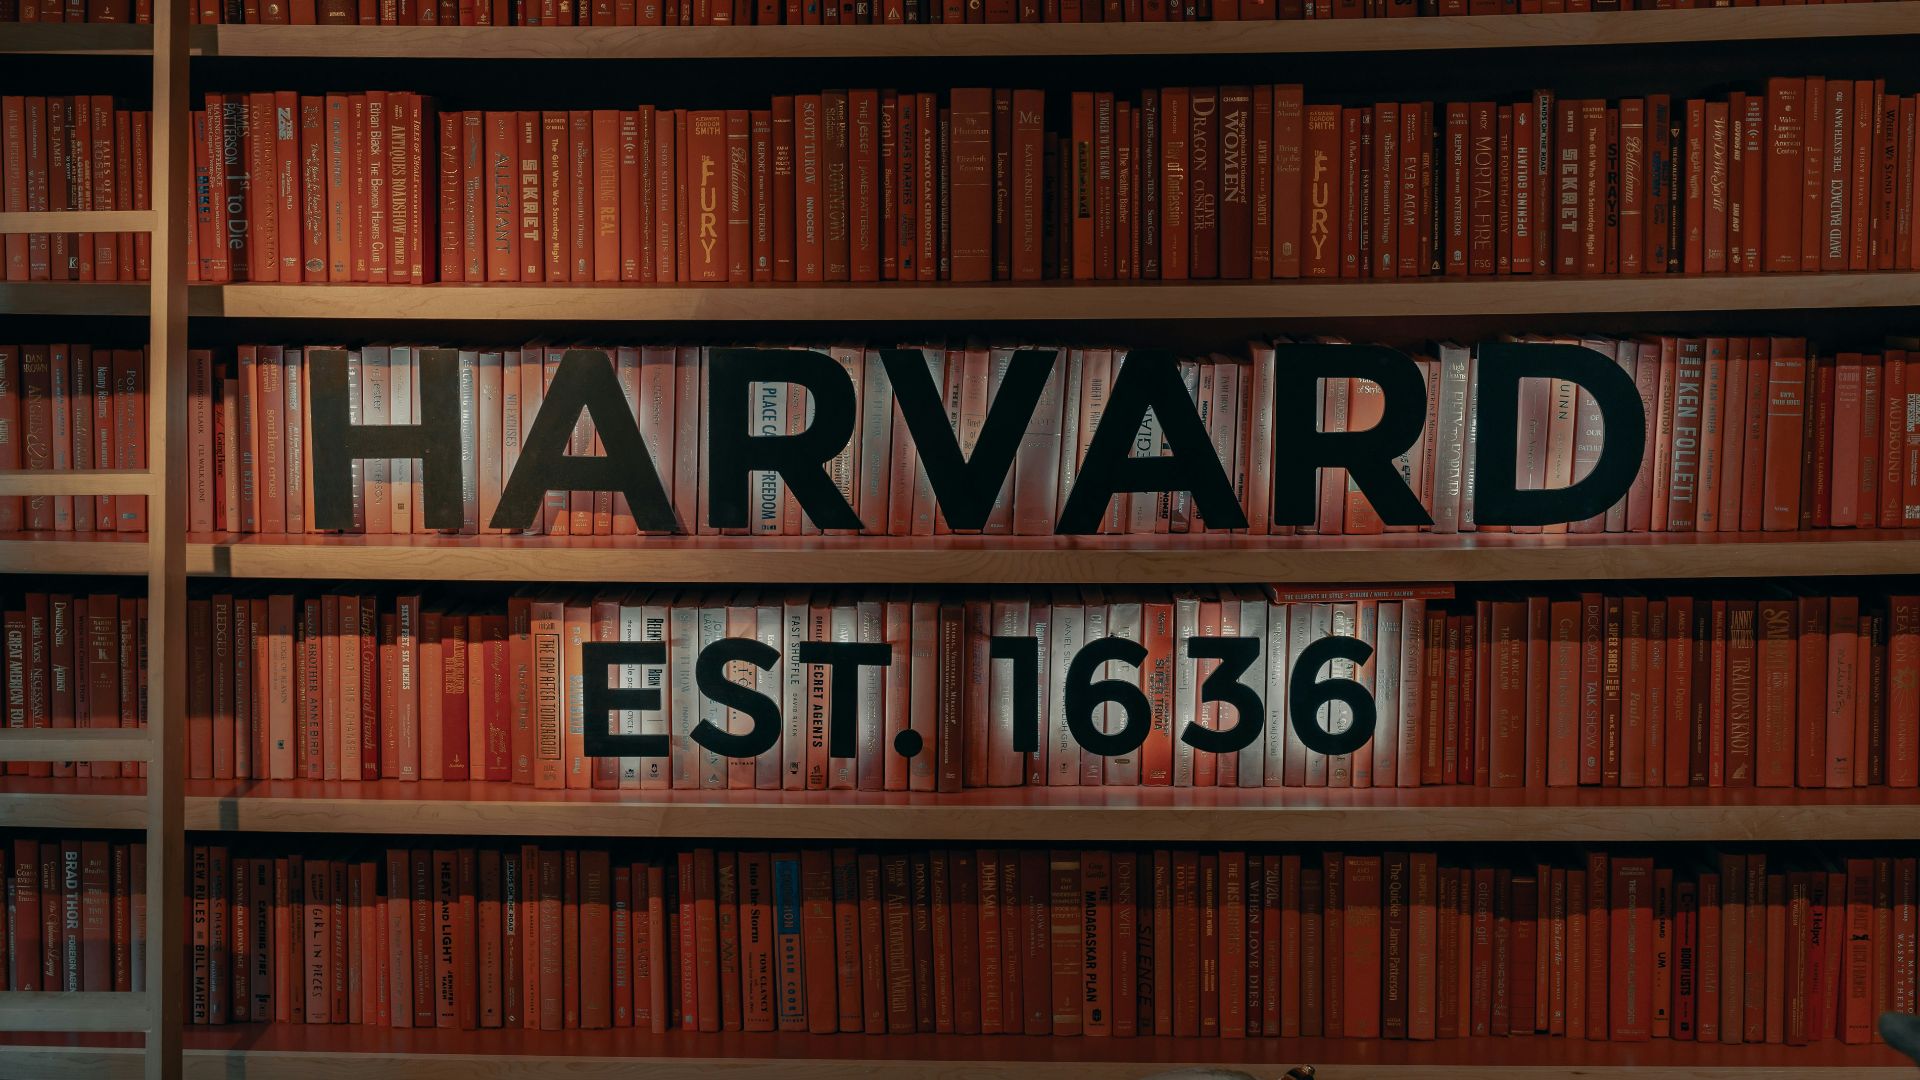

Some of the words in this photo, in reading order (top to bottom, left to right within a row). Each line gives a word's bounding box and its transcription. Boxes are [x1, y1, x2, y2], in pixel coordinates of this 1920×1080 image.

[370, 102, 382, 127] Ethan
[803, 103, 815, 139] SCOTT
[882, 104, 894, 137] Lean
[1019, 110, 1040, 124] Me
[1100, 99, 1110, 133] STRANGER
[1308, 122, 1334, 130] SMITH
[1836, 109, 1844, 127] MAN
[1886, 110, 1895, 142] WHERE
[224, 103, 238, 164] PATTERSON
[370, 131, 382, 155] Black
[390, 125, 406, 175] ANTIQUES
[882, 142, 894, 157] In
[1100, 135, 1110, 144] TO
[1193, 96, 1215, 170] DRAGON
[1834, 129, 1844, 155] SIXTH
[804, 142, 816, 184] TUROW
[1100, 146, 1110, 157] THE
[1120, 154, 1128, 166] The
[1224, 111, 1239, 203] WOMEN
[1517, 147, 1528, 187] GOLIATH
[1834, 156, 1842, 172] THE
[1886, 146, 1894, 160] WE
[600, 146, 615, 200] SOMETHING
[731, 146, 747, 213] Belladonna
[1100, 159, 1110, 180] GAME
[1117, 169, 1128, 196] Wealthy
[1475, 137, 1492, 208] MORTAL
[1625, 136, 1640, 203] Belladonna
[1884, 164, 1894, 194] STAND
[228, 194, 244, 213] to
[371, 178, 383, 208] BROKEN
[391, 178, 406, 233] ROADSHOW
[495, 152, 510, 253] ALLEGIANT
[521, 160, 539, 241] SEKRET
[1194, 180, 1205, 231] CUSSLER
[1562, 148, 1578, 232] SEKRET
[1831, 179, 1843, 226] BALDACCI
[371, 211, 383, 239] HEARTS
[551, 208, 559, 240] Saturday
[601, 207, 615, 236] REAL
[700, 160, 717, 264] FURY
[1120, 198, 1128, 223] Barber
[1205, 194, 1214, 228] CLIVE
[1310, 156, 1329, 260] FURY
[1517, 193, 1528, 237] OPENING
[1587, 199, 1595, 231] Saturday
[228, 220, 248, 249] Die
[1475, 215, 1491, 250] FIRE
[1587, 234, 1595, 254] Night
[1830, 229, 1841, 258] DAVID
[372, 242, 384, 262] CLUB
[394, 236, 405, 264] PRIMER
[96, 366, 108, 389] Nanny
[98, 391, 109, 418] Returns
[506, 395, 516, 405] NO
[762, 388, 777, 421] PLACE
[1452, 392, 1464, 426] FIFTY
[1662, 386, 1670, 434] EQUATION
[1678, 383, 1699, 418] KEN
[1906, 394, 1915, 432] EXPRESSIONS
[216, 433, 224, 454] Going
[267, 409, 278, 463] southern
[309, 342, 1646, 536] HARVARD
[506, 407, 516, 447] EXCUSES
[1889, 397, 1901, 483] MUDBOUND
[1448, 443, 1461, 496] FOREVER
[1673, 426, 1697, 503] FOLLETT
[268, 467, 277, 498] cross
[216, 603, 227, 657] PLEDGED
[236, 606, 245, 657] LENCIONI
[360, 607, 373, 648] Harper's
[792, 616, 800, 639] FAST
[1587, 605, 1599, 631] DICK
[1608, 622, 1618, 646] SUPER
[8, 631, 23, 660] GREAT
[539, 640, 554, 654] THE
[1587, 635, 1599, 673] CAVETT
[1608, 649, 1618, 673] SHRED
[308, 644, 318, 692] BROTHER
[540, 657, 555, 674] DAY
[792, 643, 800, 684] SHUFFLE
[1155, 659, 1164, 694] SUPER
[8, 661, 23, 705] AMERICAN
[33, 668, 43, 720] NECESSARY
[540, 676, 555, 701] AFTER
[584, 636, 922, 757] EST.
[991, 635, 1377, 756] 1636
[1586, 681, 1598, 706] TALK
[1730, 656, 1750, 719] TRAITOR'S
[310, 698, 318, 727] ANNE
[362, 704, 374, 713] of
[1154, 698, 1164, 730] TRIVIA
[1630, 692, 1641, 726] Paula
[364, 714, 376, 750] French
[540, 703, 556, 755] TOMORROW
[812, 704, 824, 748] AGENTS
[1586, 710, 1598, 749] SHOW
[1731, 723, 1748, 756] KNOT
[310, 731, 319, 756] BIRD
[65, 851, 78, 889] BRAD
[196, 853, 204, 878] NEW
[441, 862, 451, 896] HEAT
[750, 863, 759, 886] Into
[983, 863, 996, 891] JOHN
[1390, 863, 1402, 881] The
[66, 892, 78, 929] THOR
[196, 886, 204, 923] RULES
[750, 888, 760, 906] the
[984, 894, 996, 917] SAUL
[1249, 880, 1259, 925] WHEN
[1389, 882, 1402, 917] Quickie
[1479, 882, 1489, 922] citizen
[313, 908, 324, 938] GIRL
[752, 909, 760, 943] Storm
[1086, 891, 1096, 969] MADAGASKAR
[1476, 927, 1489, 945] girl
[68, 935, 77, 969] FOREIGN
[196, 945, 204, 971] BILL
[313, 945, 320, 958] IN
[442, 925, 452, 964] LIGHT
[1249, 931, 1259, 969] LOVE
[1389, 927, 1401, 955] James
[312, 964, 322, 997] PIECES
[1138, 924, 1152, 1008] SILENCE
[1388, 957, 1401, 1001] Patterson
[196, 977, 204, 1018] MAHER
[760, 976, 768, 1012] CLANCY
[1086, 973, 1097, 1002] PLAN
[1249, 975, 1259, 1008] DIES
